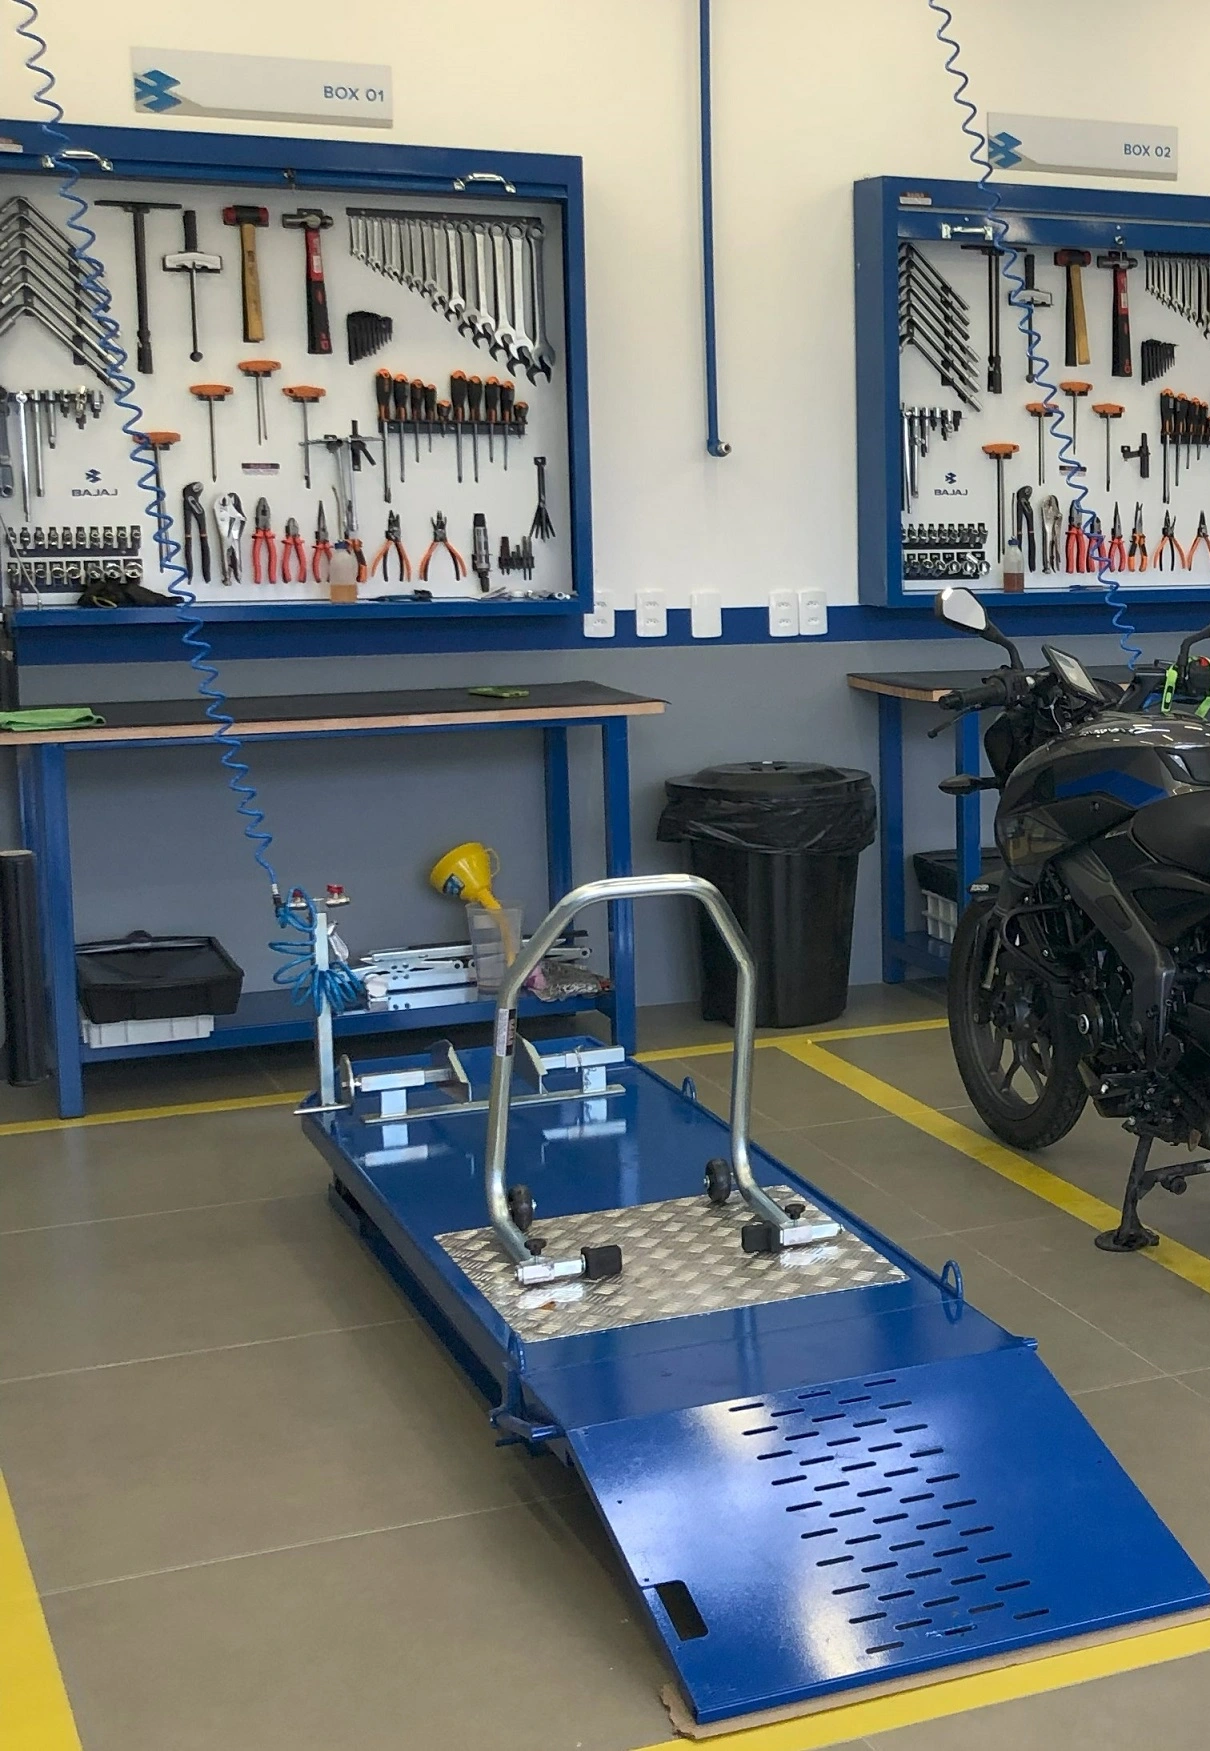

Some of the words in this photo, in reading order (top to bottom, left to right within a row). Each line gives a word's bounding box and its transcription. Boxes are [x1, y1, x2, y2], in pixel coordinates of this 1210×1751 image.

[323, 85, 359, 101] BOX
[366, 88, 384, 102] 01
[1124, 143, 1150, 157] BOX
[1155, 146, 1171, 158] 02
[71, 488, 118, 497] BAJAJ
[934, 488, 968, 496] BAJAJ
